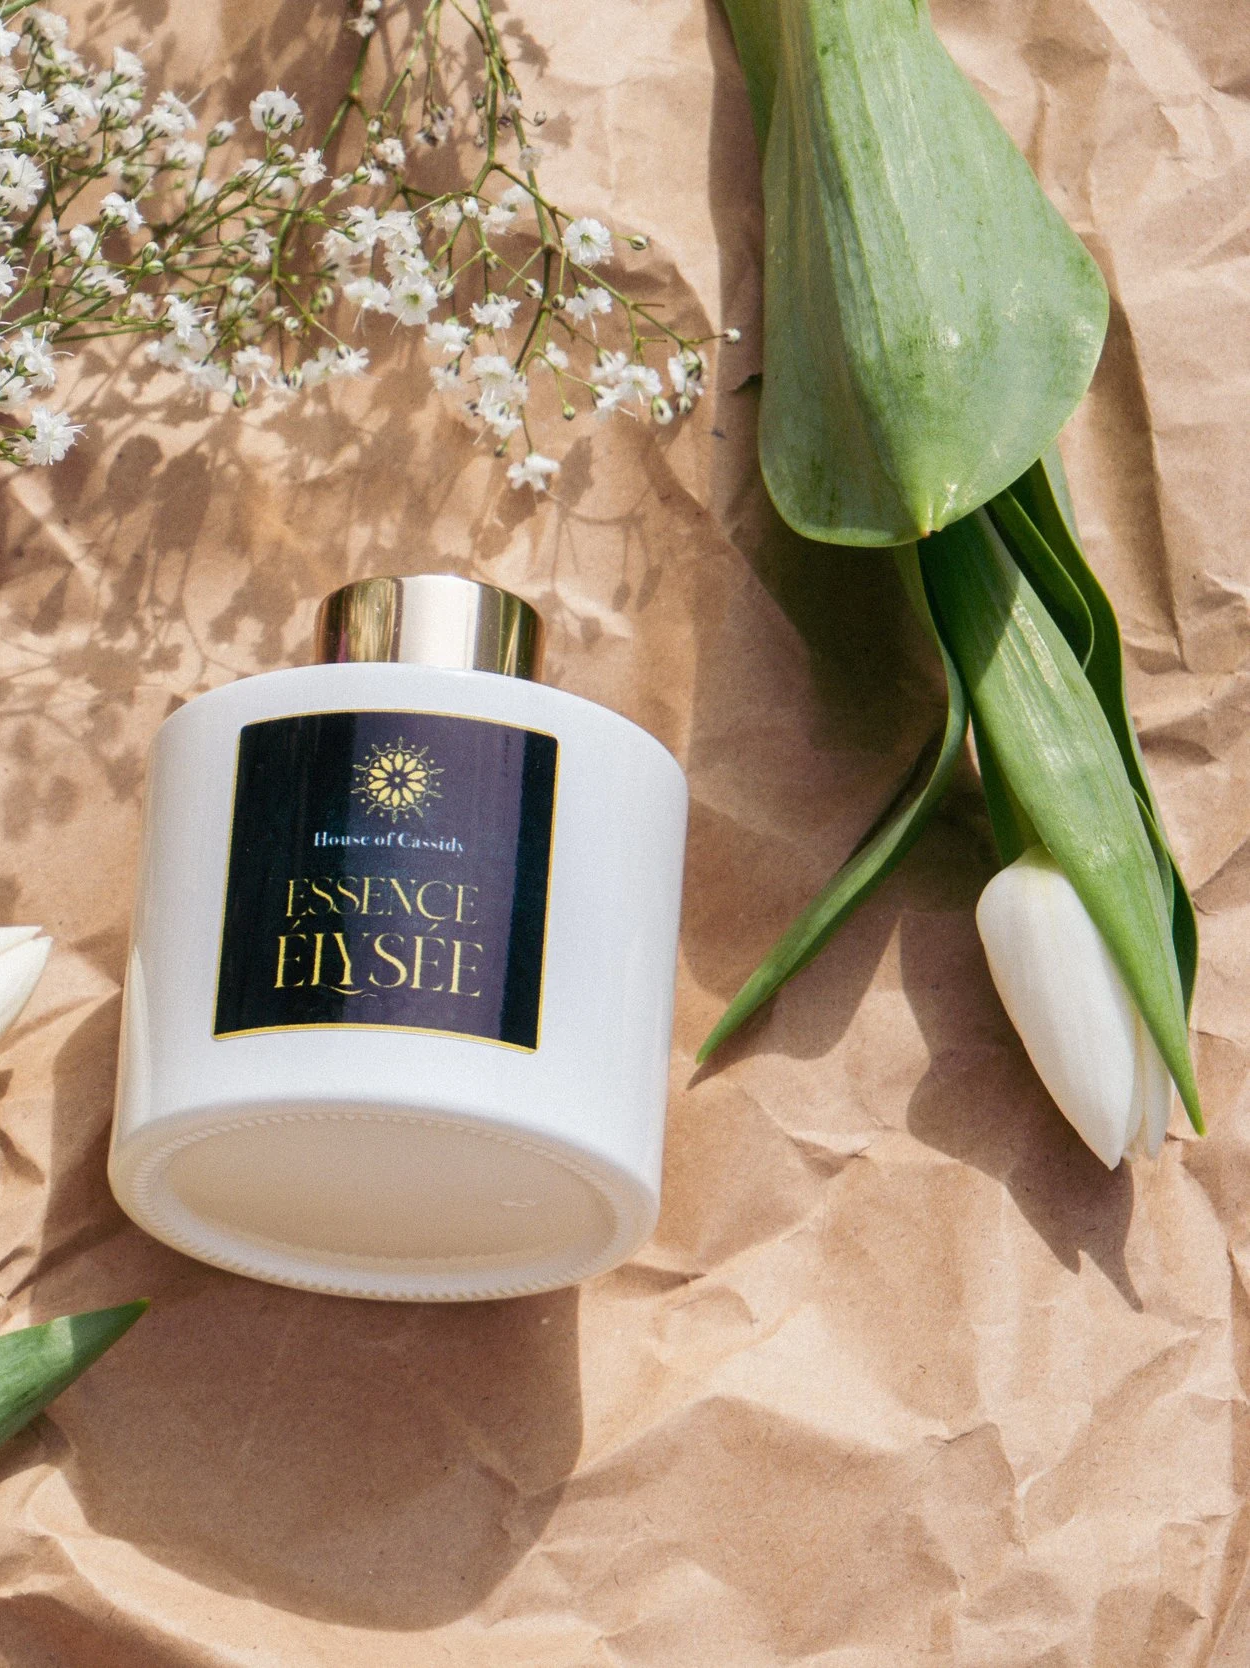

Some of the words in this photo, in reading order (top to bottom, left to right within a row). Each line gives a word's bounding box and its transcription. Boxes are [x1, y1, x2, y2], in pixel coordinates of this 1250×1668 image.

[314, 831, 370, 847] House
[374, 831, 396, 847] of
[397, 832, 464, 857] Cassidy
[285, 876, 479, 924] ESSENCE
[274, 919, 483, 998] ÉLYSÉE
